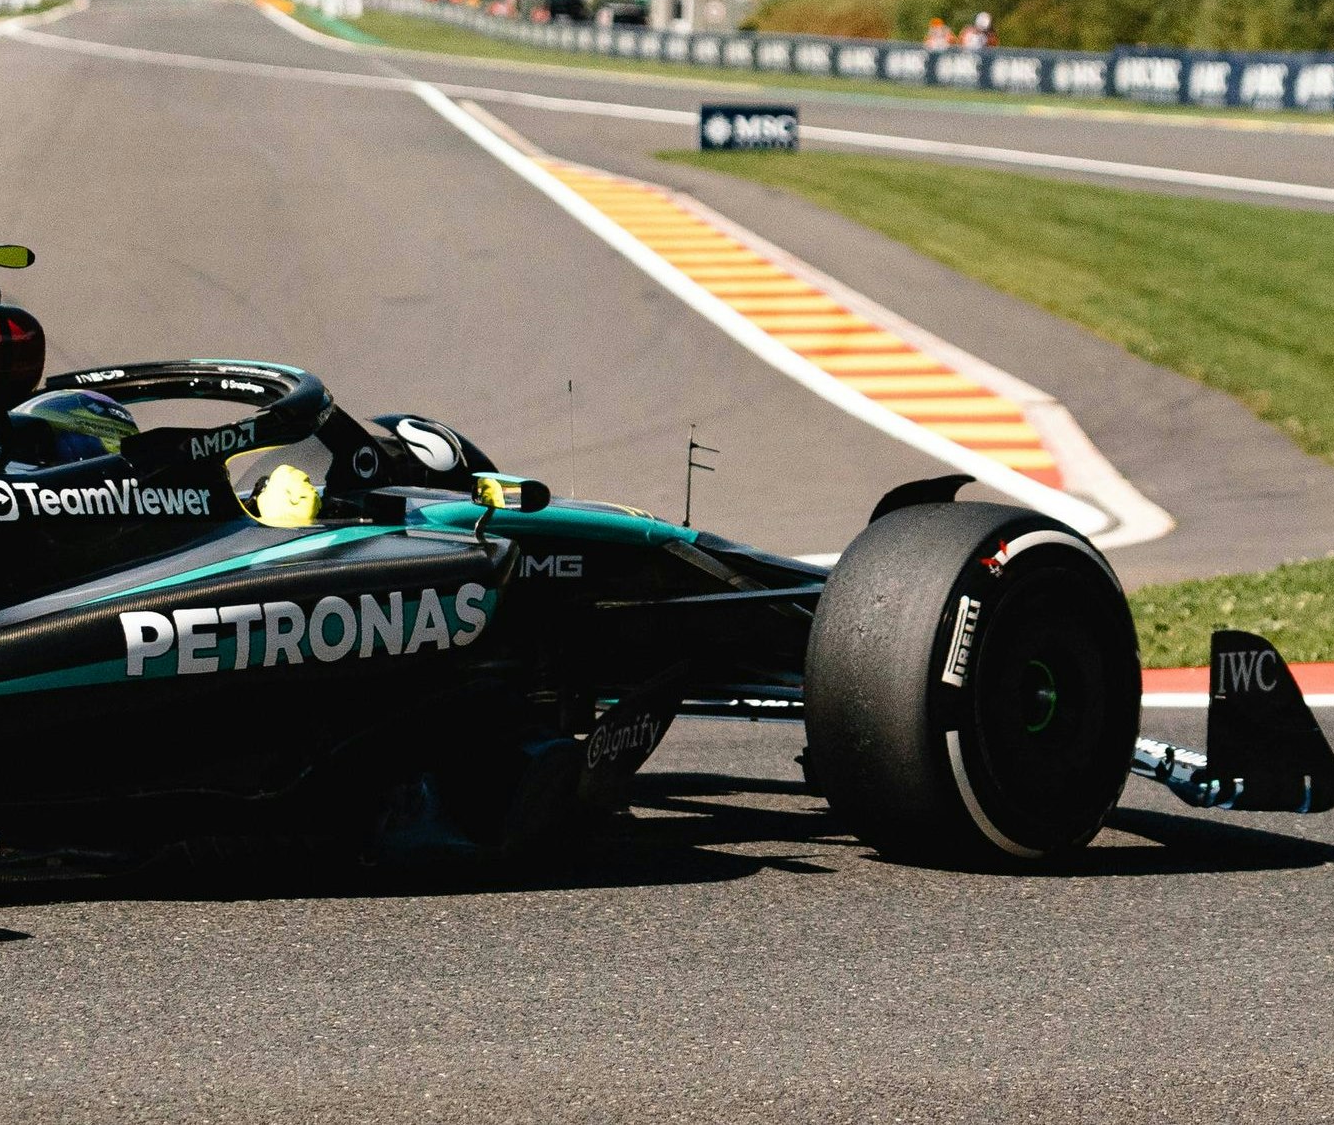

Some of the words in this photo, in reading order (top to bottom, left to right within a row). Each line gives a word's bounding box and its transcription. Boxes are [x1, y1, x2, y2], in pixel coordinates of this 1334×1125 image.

[732, 114, 798, 139] MSC
[191, 429, 237, 460] AMD
[13, 478, 211, 517] TeamViewer
[519, 555, 583, 577] MG
[119, 582, 488, 676] PETRONAS
[942, 595, 981, 688] PIRELLI
[1218, 650, 1278, 694] IWC
